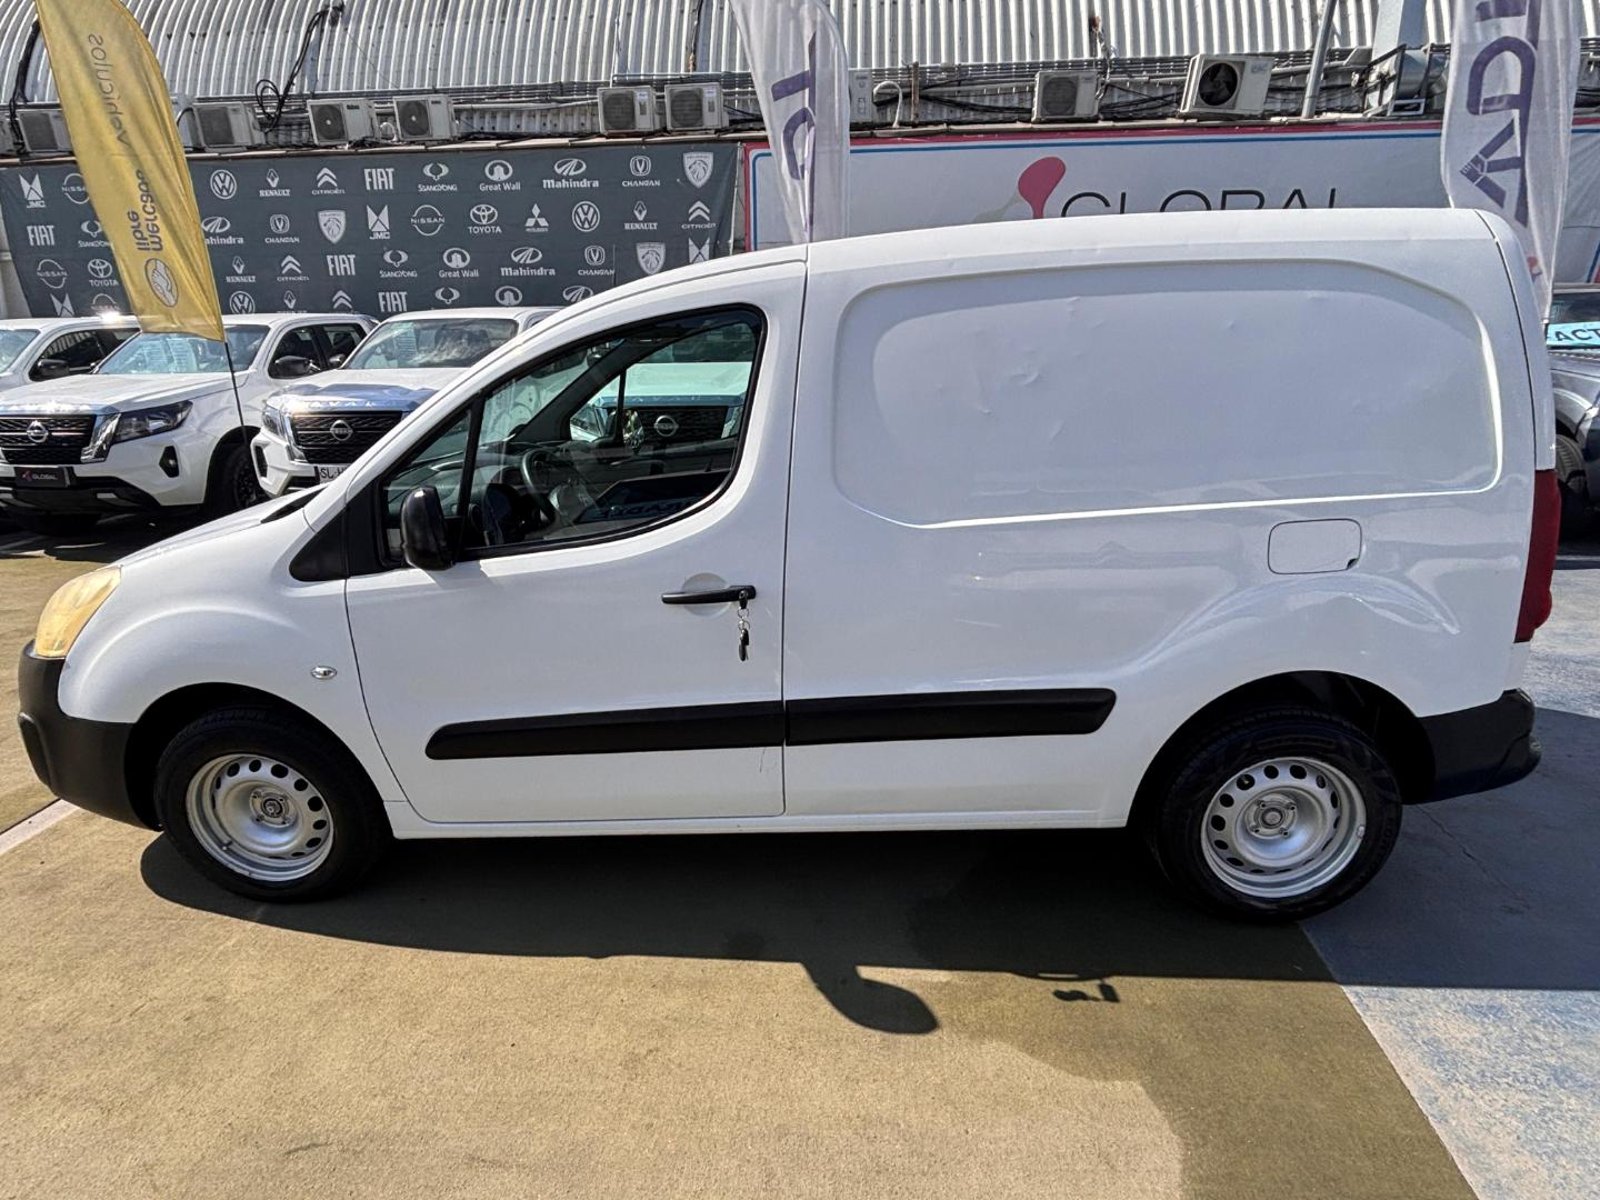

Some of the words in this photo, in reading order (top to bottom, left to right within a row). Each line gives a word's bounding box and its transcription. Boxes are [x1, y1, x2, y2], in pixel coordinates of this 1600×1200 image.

[363, 168, 394, 190] FIAT
[542, 178, 600, 189] Mahindra
[479, 182, 502, 192] Great
[503, 182, 521, 191] Wall
[259, 189, 291, 197] RENAULT
[26, 200, 47, 209] JMC
[467, 226, 503, 234] TOYOTA
[27, 225, 55, 247] FIAT
[204, 235, 244, 246] ahindra
[369, 232, 391, 240] JMC
[326, 255, 356, 276] FIAT
[438, 269, 461, 278] Great
[462, 269, 480, 278] Wall
[500, 267, 556, 277] Mahindra
[89, 279, 119, 287] TOYOTA
[378, 291, 408, 312] FIAT
